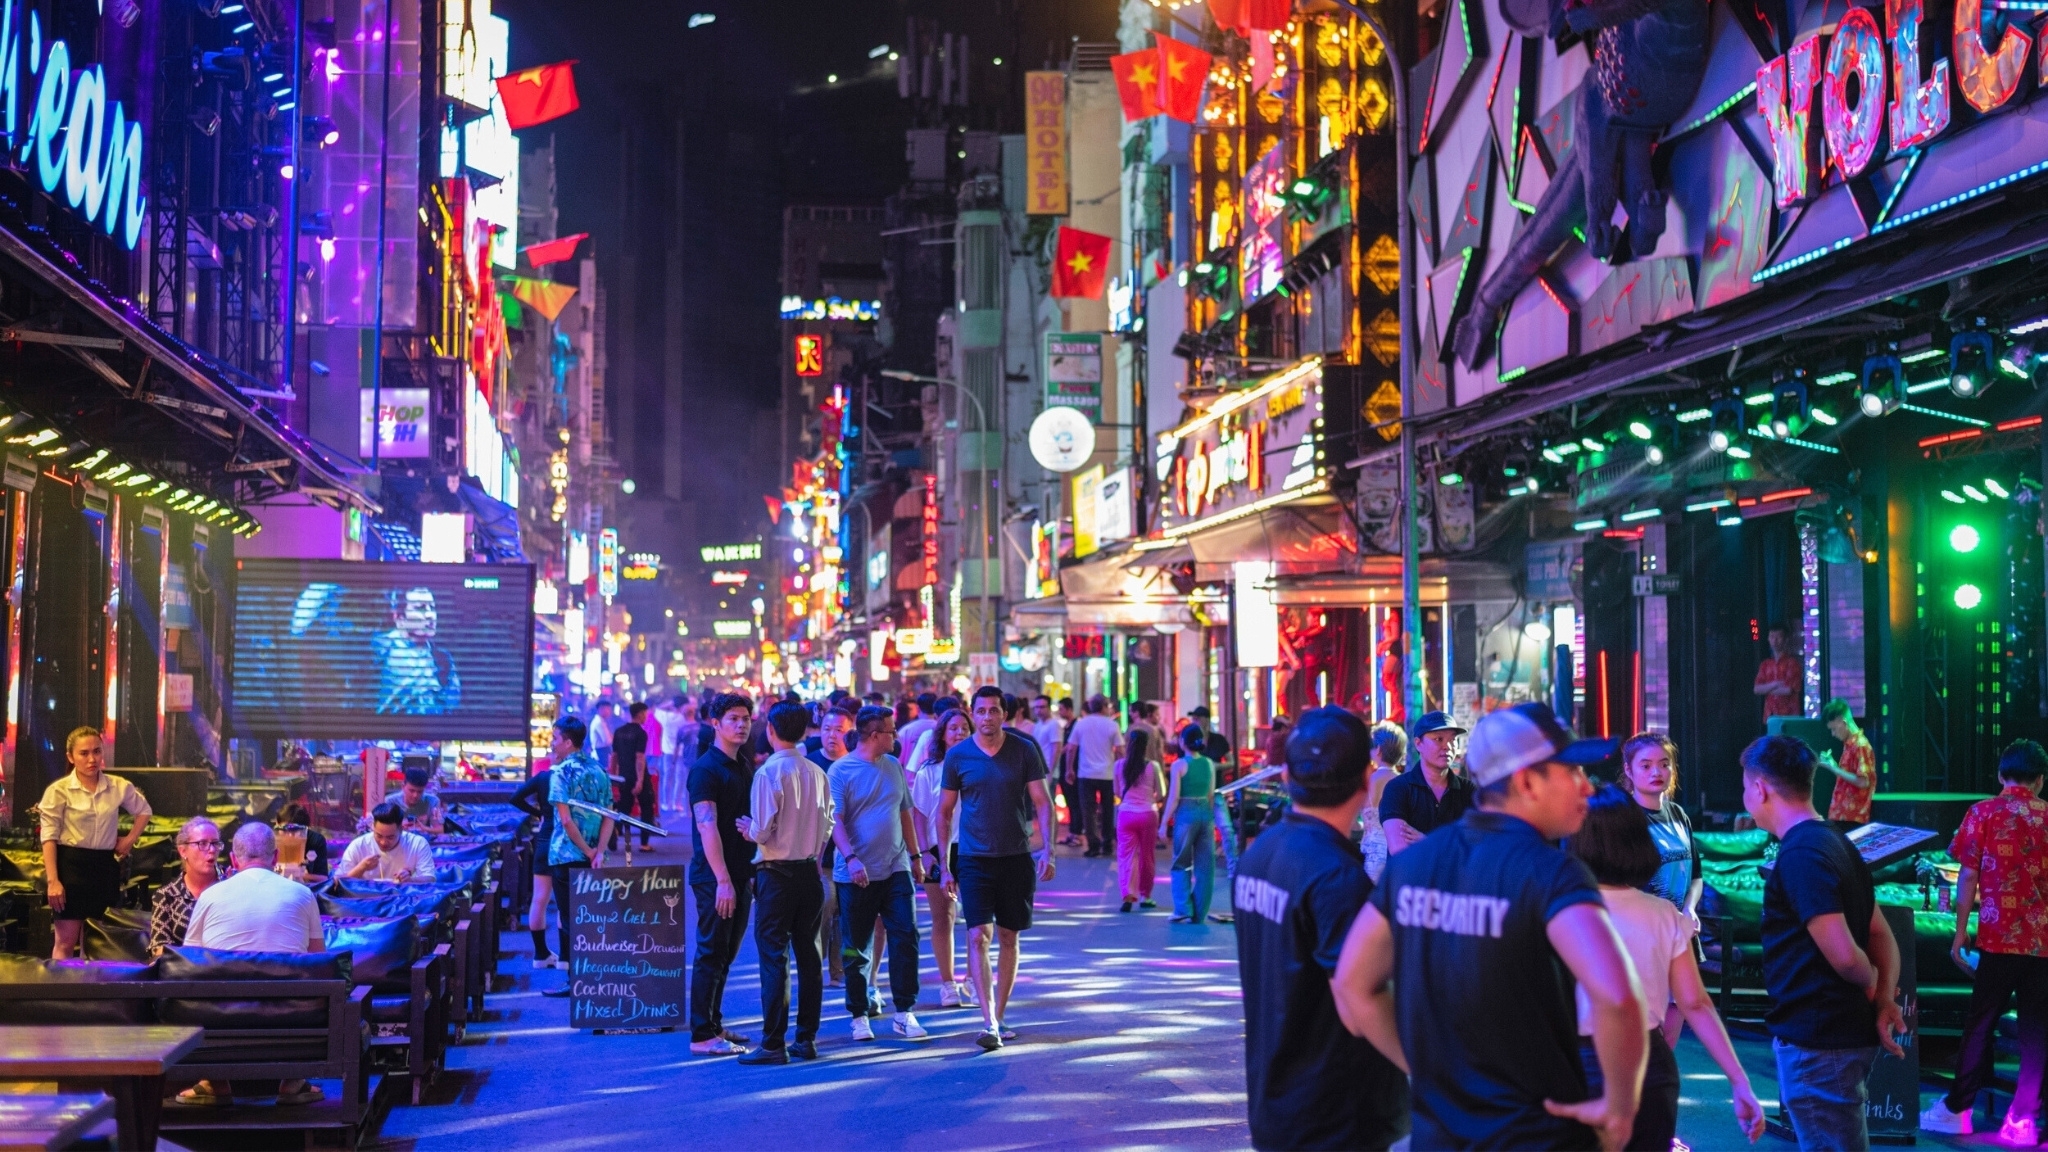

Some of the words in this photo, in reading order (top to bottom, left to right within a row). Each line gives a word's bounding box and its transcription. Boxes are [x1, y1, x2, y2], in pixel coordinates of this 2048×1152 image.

[1756, 0, 2048, 212] VOLC
[1034, 109, 1059, 210] HOTEL
[923, 476, 939, 535] TINA
[924, 540, 939, 584] SPA
[573, 870, 634, 903] Happy
[640, 867, 682, 894] Hour
[1235, 874, 1289, 925] ECURITY
[575, 904, 607, 933] Buy
[650, 912, 661, 925] 1
[1395, 885, 1510, 938] SECURITY
[573, 934, 638, 954] Budweiser
